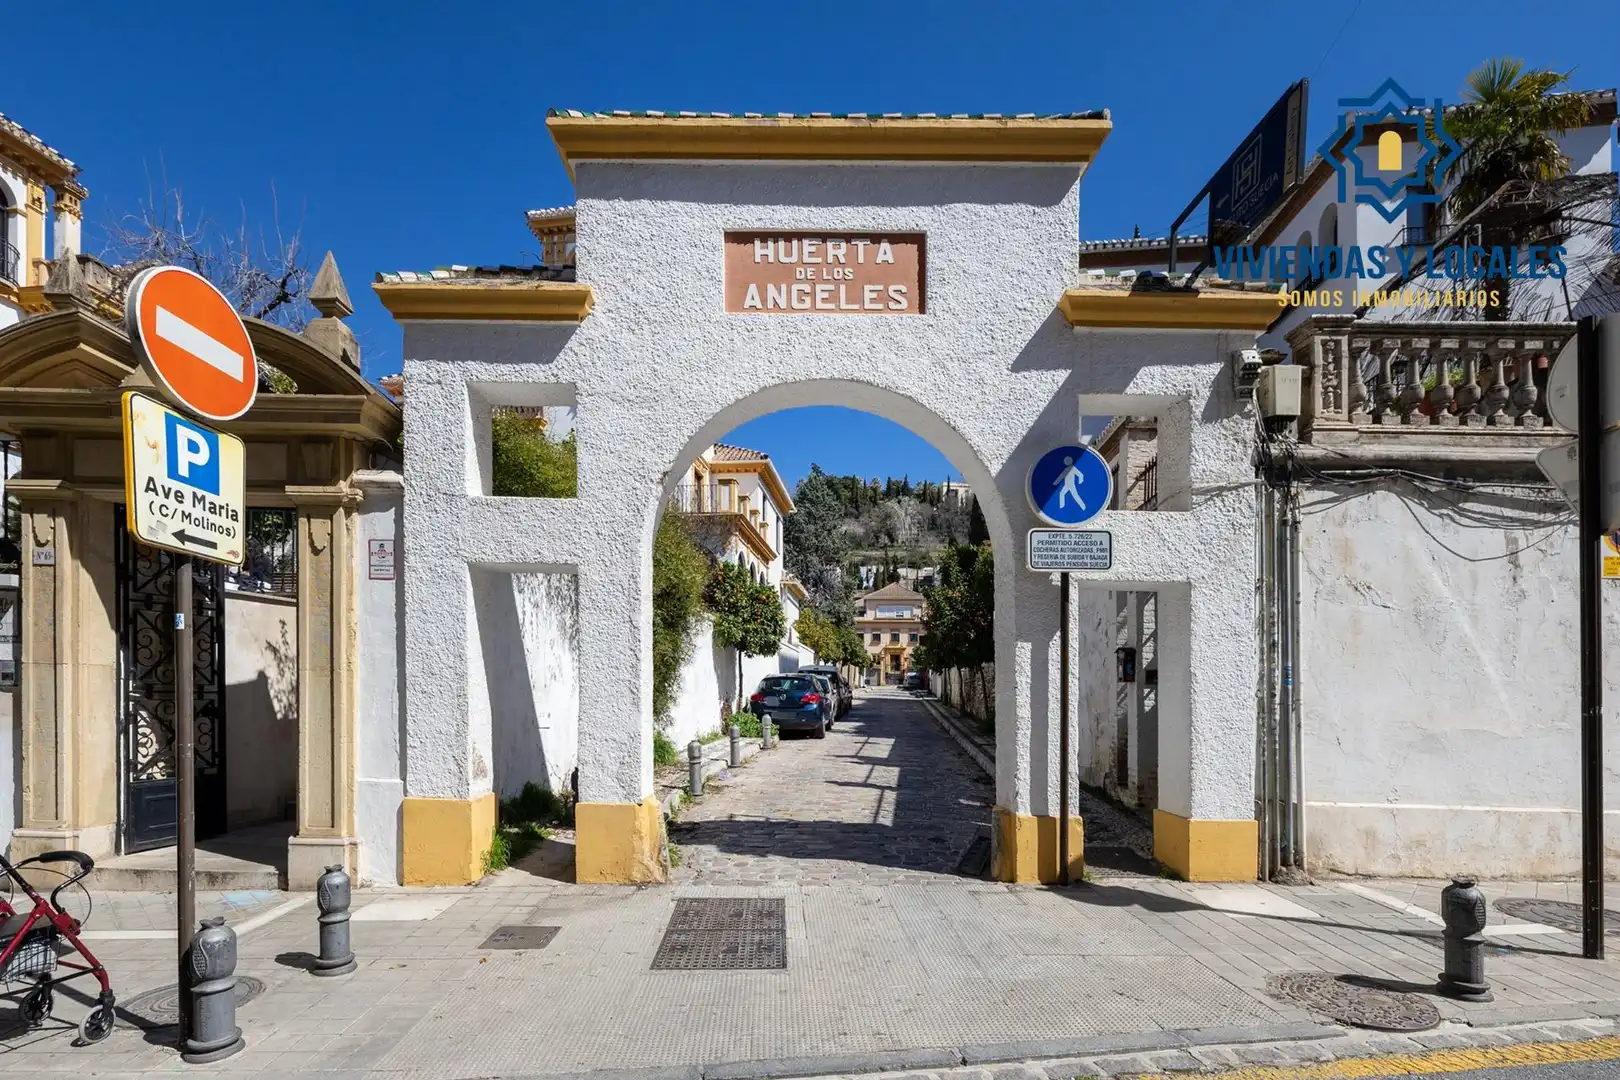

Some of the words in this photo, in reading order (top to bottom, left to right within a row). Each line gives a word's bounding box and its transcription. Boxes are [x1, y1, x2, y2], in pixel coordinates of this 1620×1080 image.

[753, 238, 895, 264] HUERTA
[796, 267, 816, 280] DE
[822, 267, 854, 280] LOS
[743, 283, 908, 310] ANGELES
[176, 423, 210, 478] P
[144, 476, 185, 505] Ave
[192, 491, 239, 523] Maria
